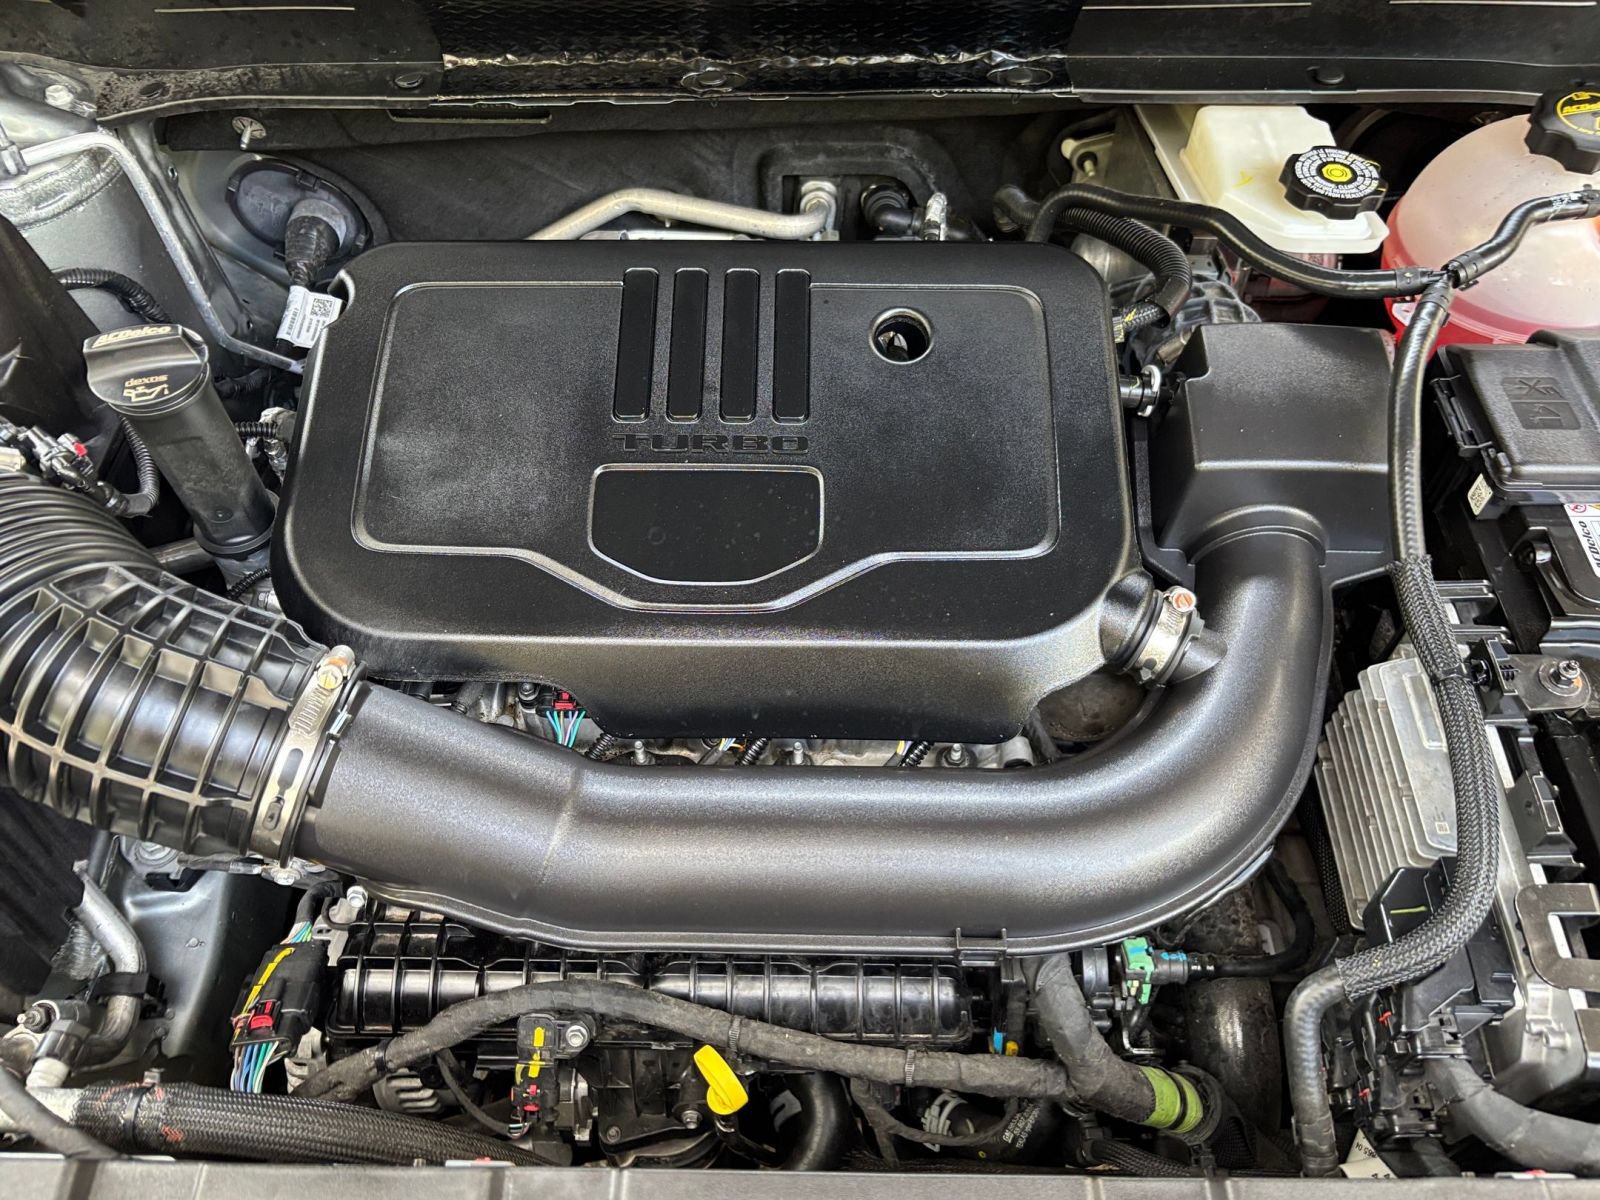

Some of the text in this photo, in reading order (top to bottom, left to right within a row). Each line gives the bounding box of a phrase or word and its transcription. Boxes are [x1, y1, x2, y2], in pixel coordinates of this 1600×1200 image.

[91, 326, 172, 349] ACDelco
[125, 374, 168, 387] dexos
[612, 433, 809, 453] TURBO
